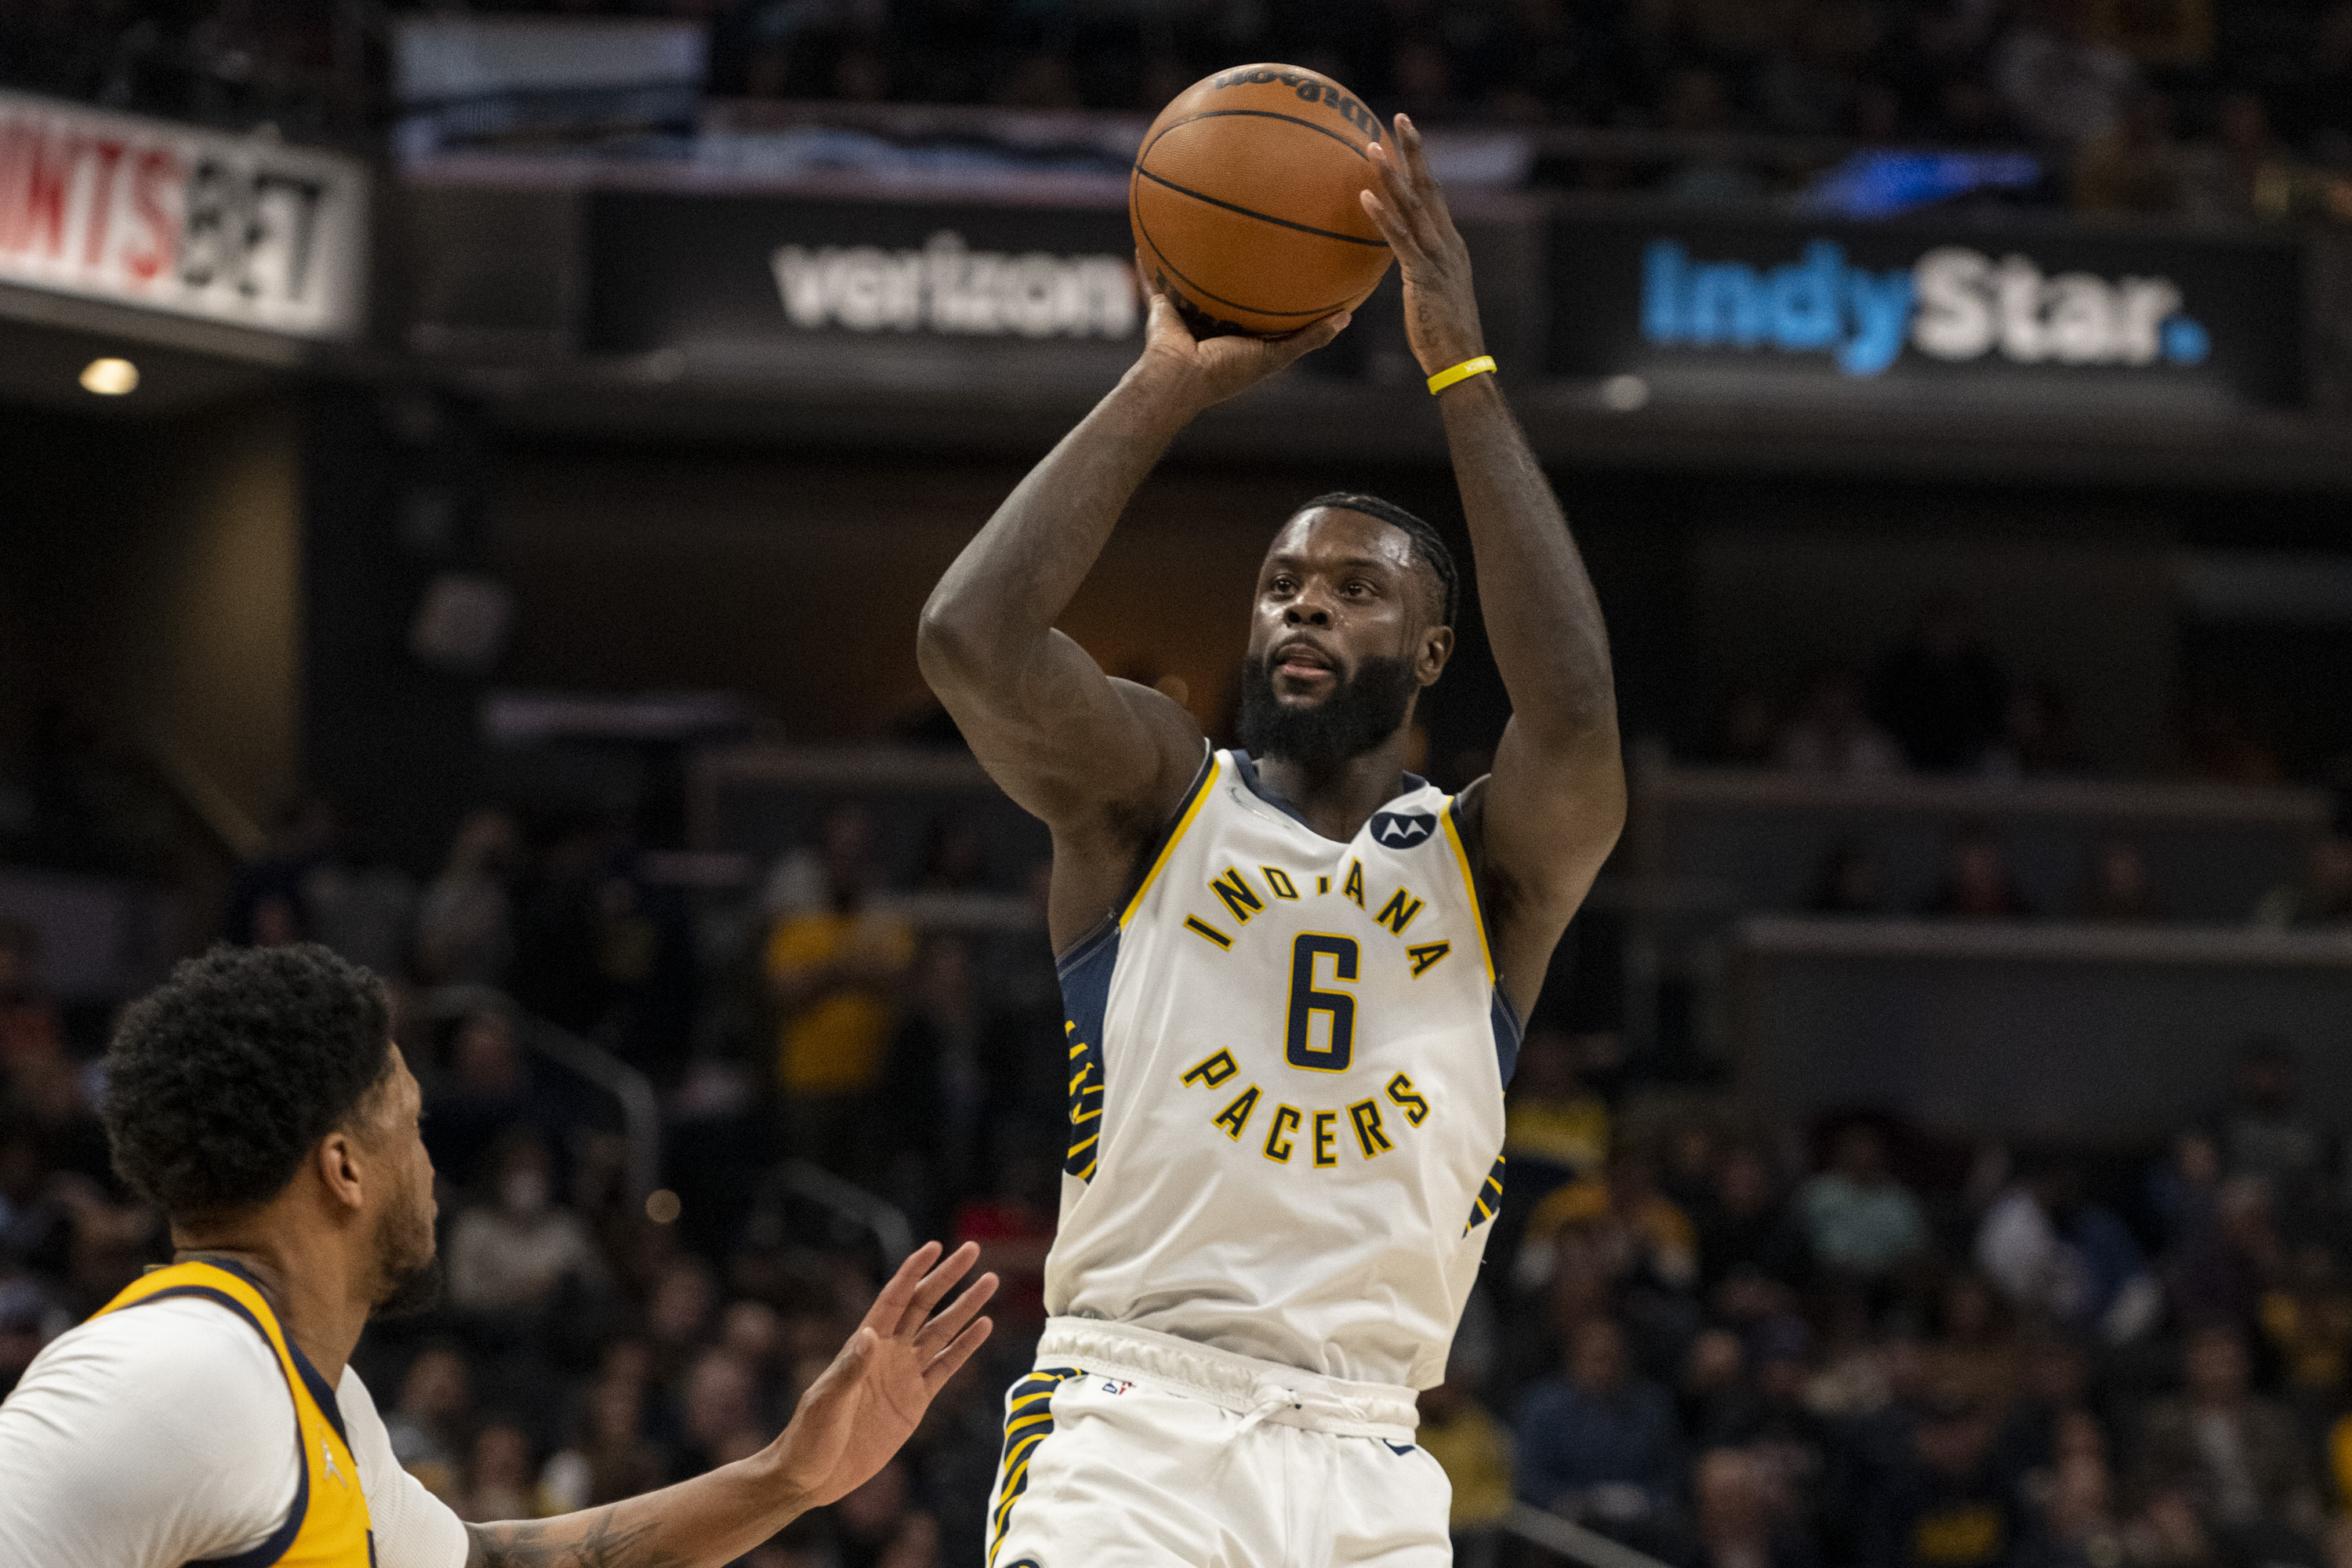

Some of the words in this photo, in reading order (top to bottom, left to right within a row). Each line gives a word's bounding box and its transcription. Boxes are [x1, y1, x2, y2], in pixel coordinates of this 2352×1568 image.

[773, 232, 1138, 337] verizon
[1183, 856, 1450, 979] INDIANA
[1283, 930, 1361, 1073] 6
[1180, 1047, 1431, 1169] PACERS
